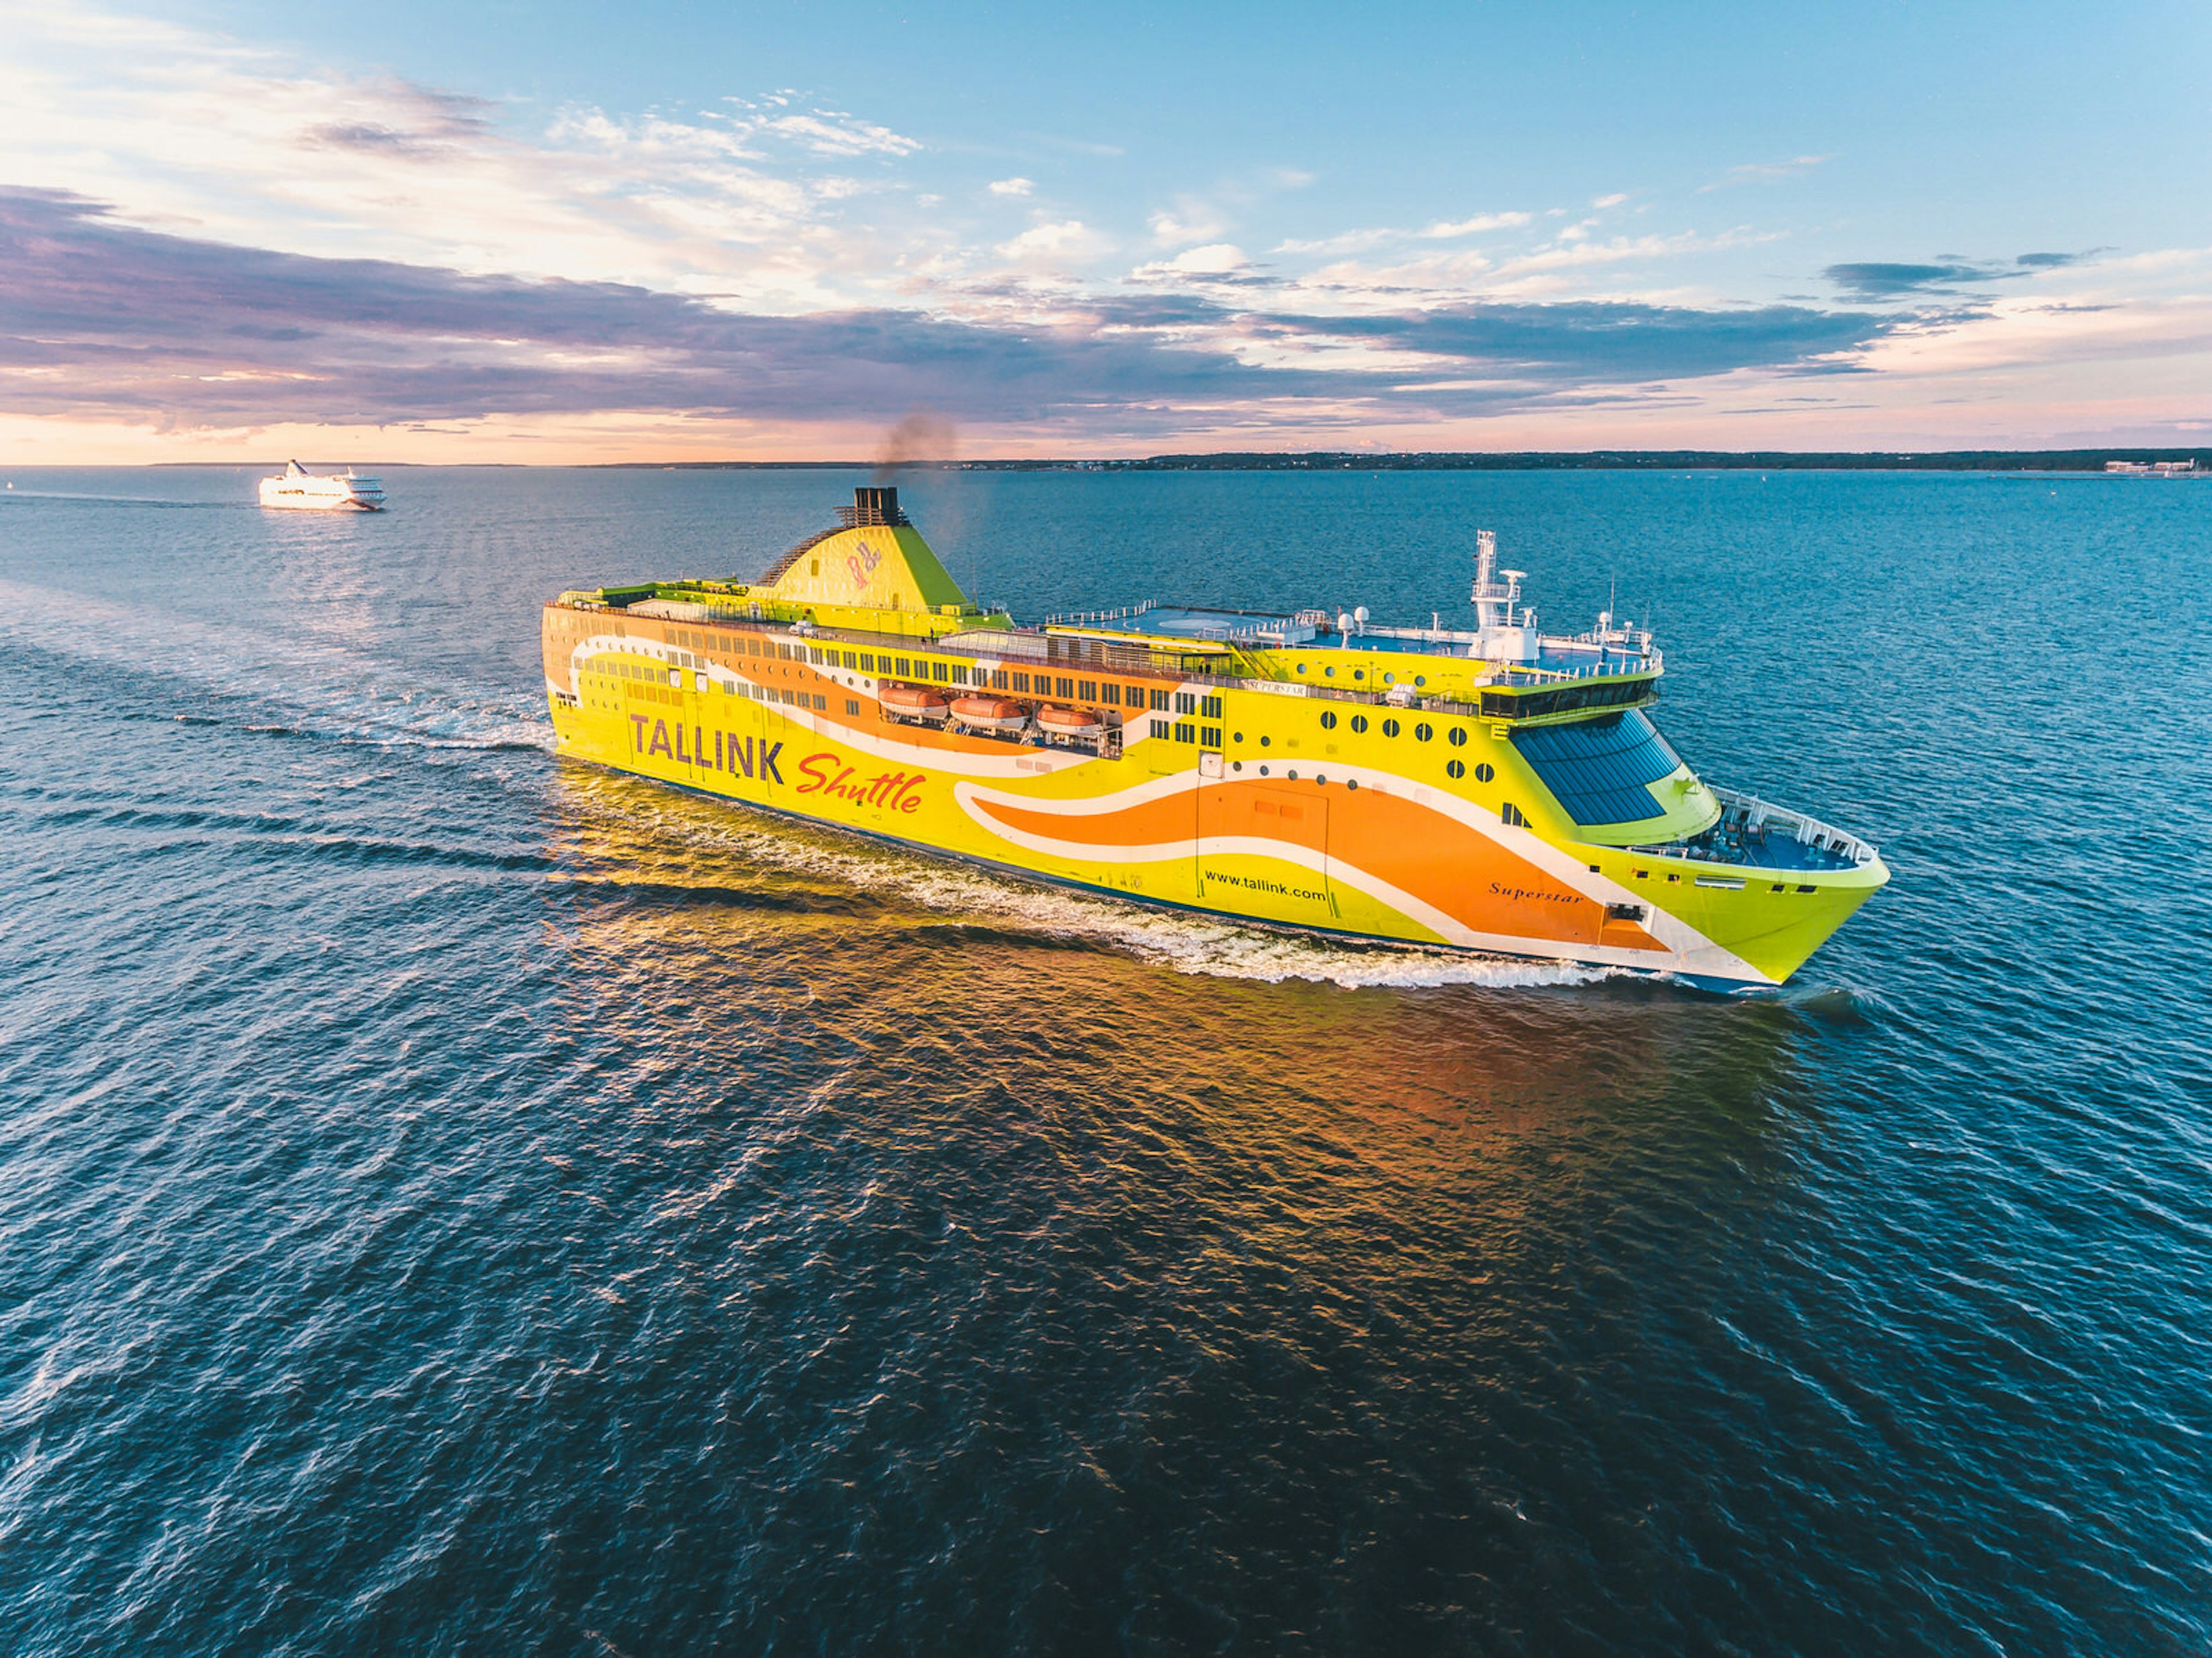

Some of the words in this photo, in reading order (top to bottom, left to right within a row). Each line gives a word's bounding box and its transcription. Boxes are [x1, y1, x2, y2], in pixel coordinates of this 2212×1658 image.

[630, 714, 784, 785] TALLINK
[796, 753, 926, 813] Shuttle
[1205, 870, 1326, 901] www.tallink.com
[1489, 882, 1584, 903] Superstar
